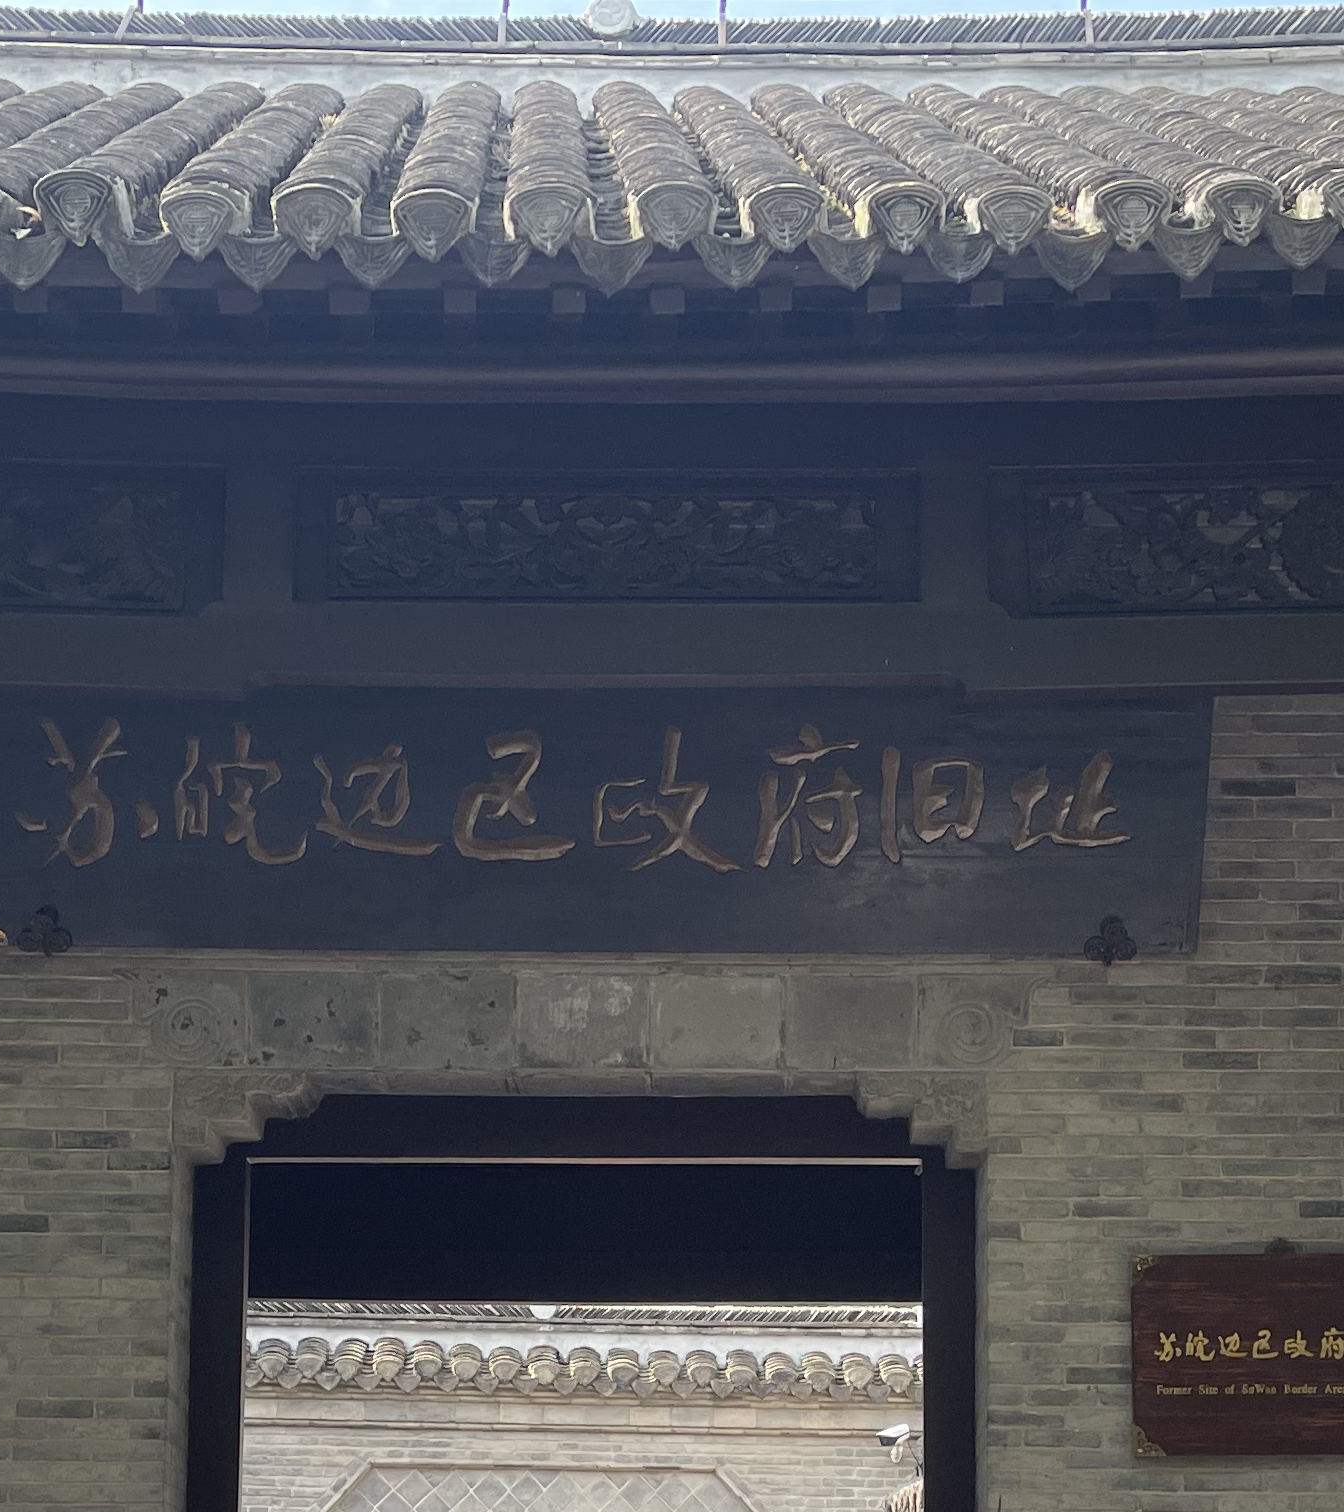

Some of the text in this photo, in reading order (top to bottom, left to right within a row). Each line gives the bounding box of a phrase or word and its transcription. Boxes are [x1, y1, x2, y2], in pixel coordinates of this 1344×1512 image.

[15, 717, 1133, 873] 苏皖边区政府旧址
[1156, 1384, 1192, 1395] Former
[1198, 1383, 1218, 1395] Site
[1224, 1384, 1235, 1395] of
[1241, 1383, 1277, 1395] SuWan
[1284, 1383, 1317, 1394] Border
